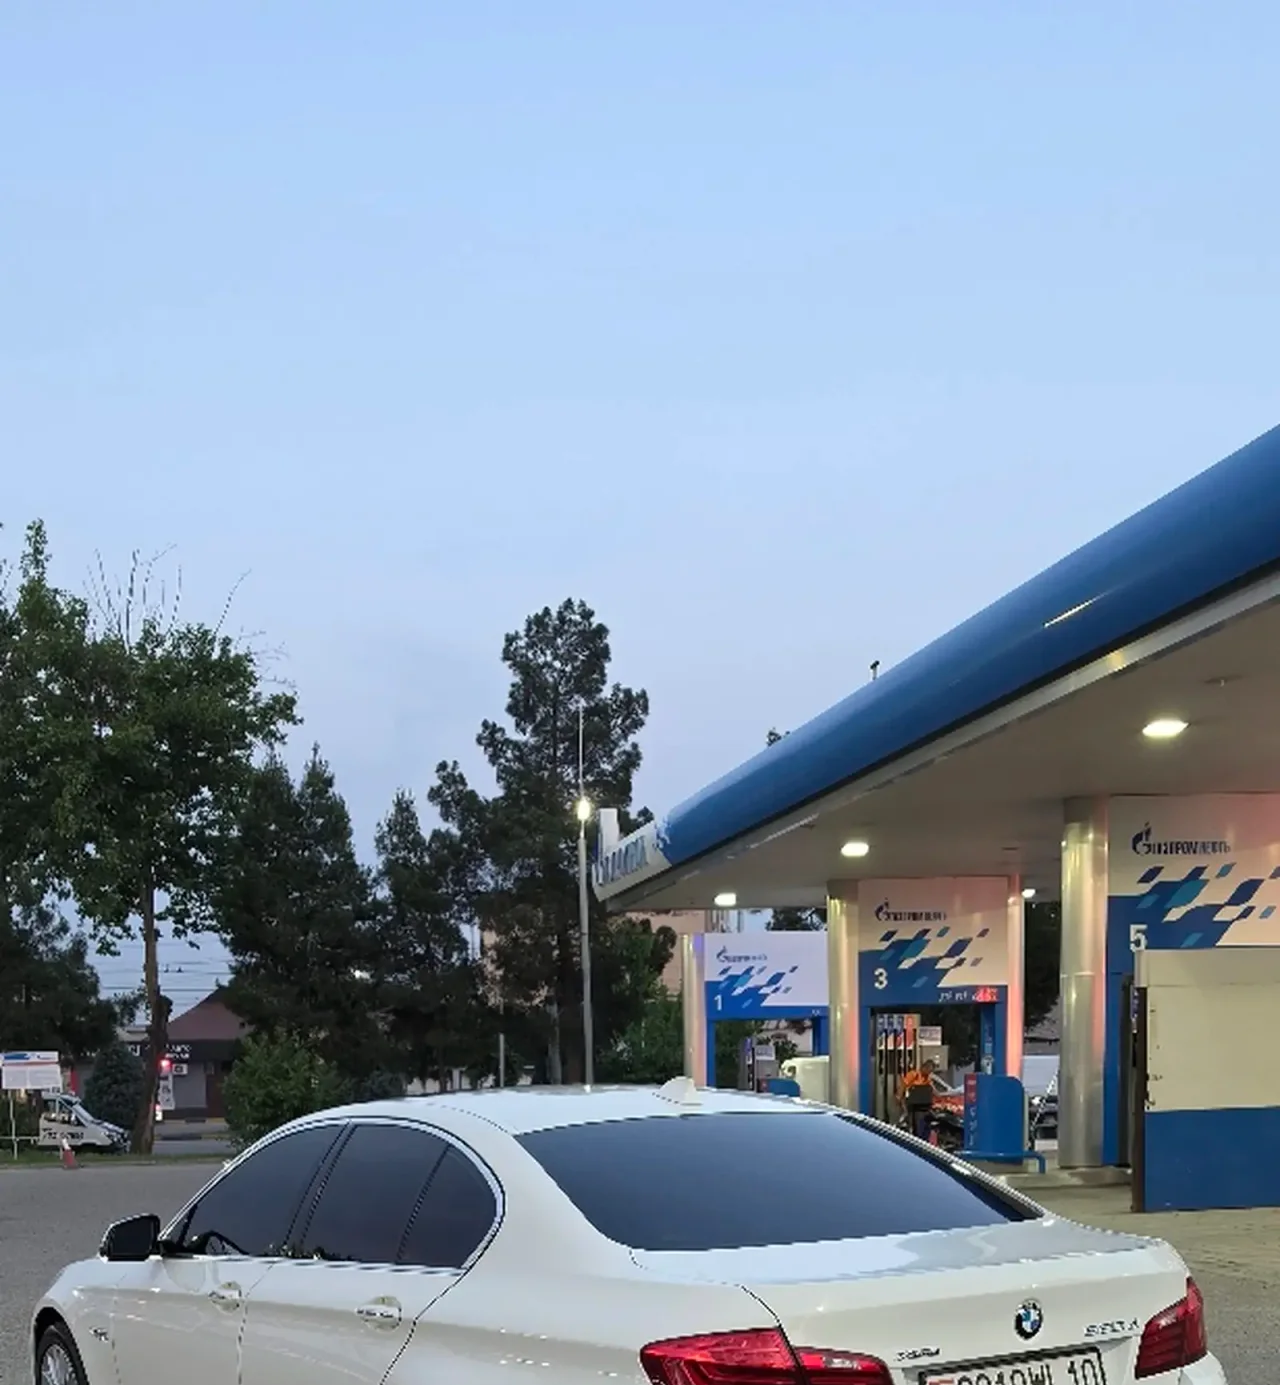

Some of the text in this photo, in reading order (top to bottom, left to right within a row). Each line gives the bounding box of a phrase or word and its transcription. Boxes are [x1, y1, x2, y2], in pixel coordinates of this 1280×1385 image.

[1129, 924, 1148, 952] 5
[874, 967, 889, 989] 3
[714, 994, 723, 1011] 1
